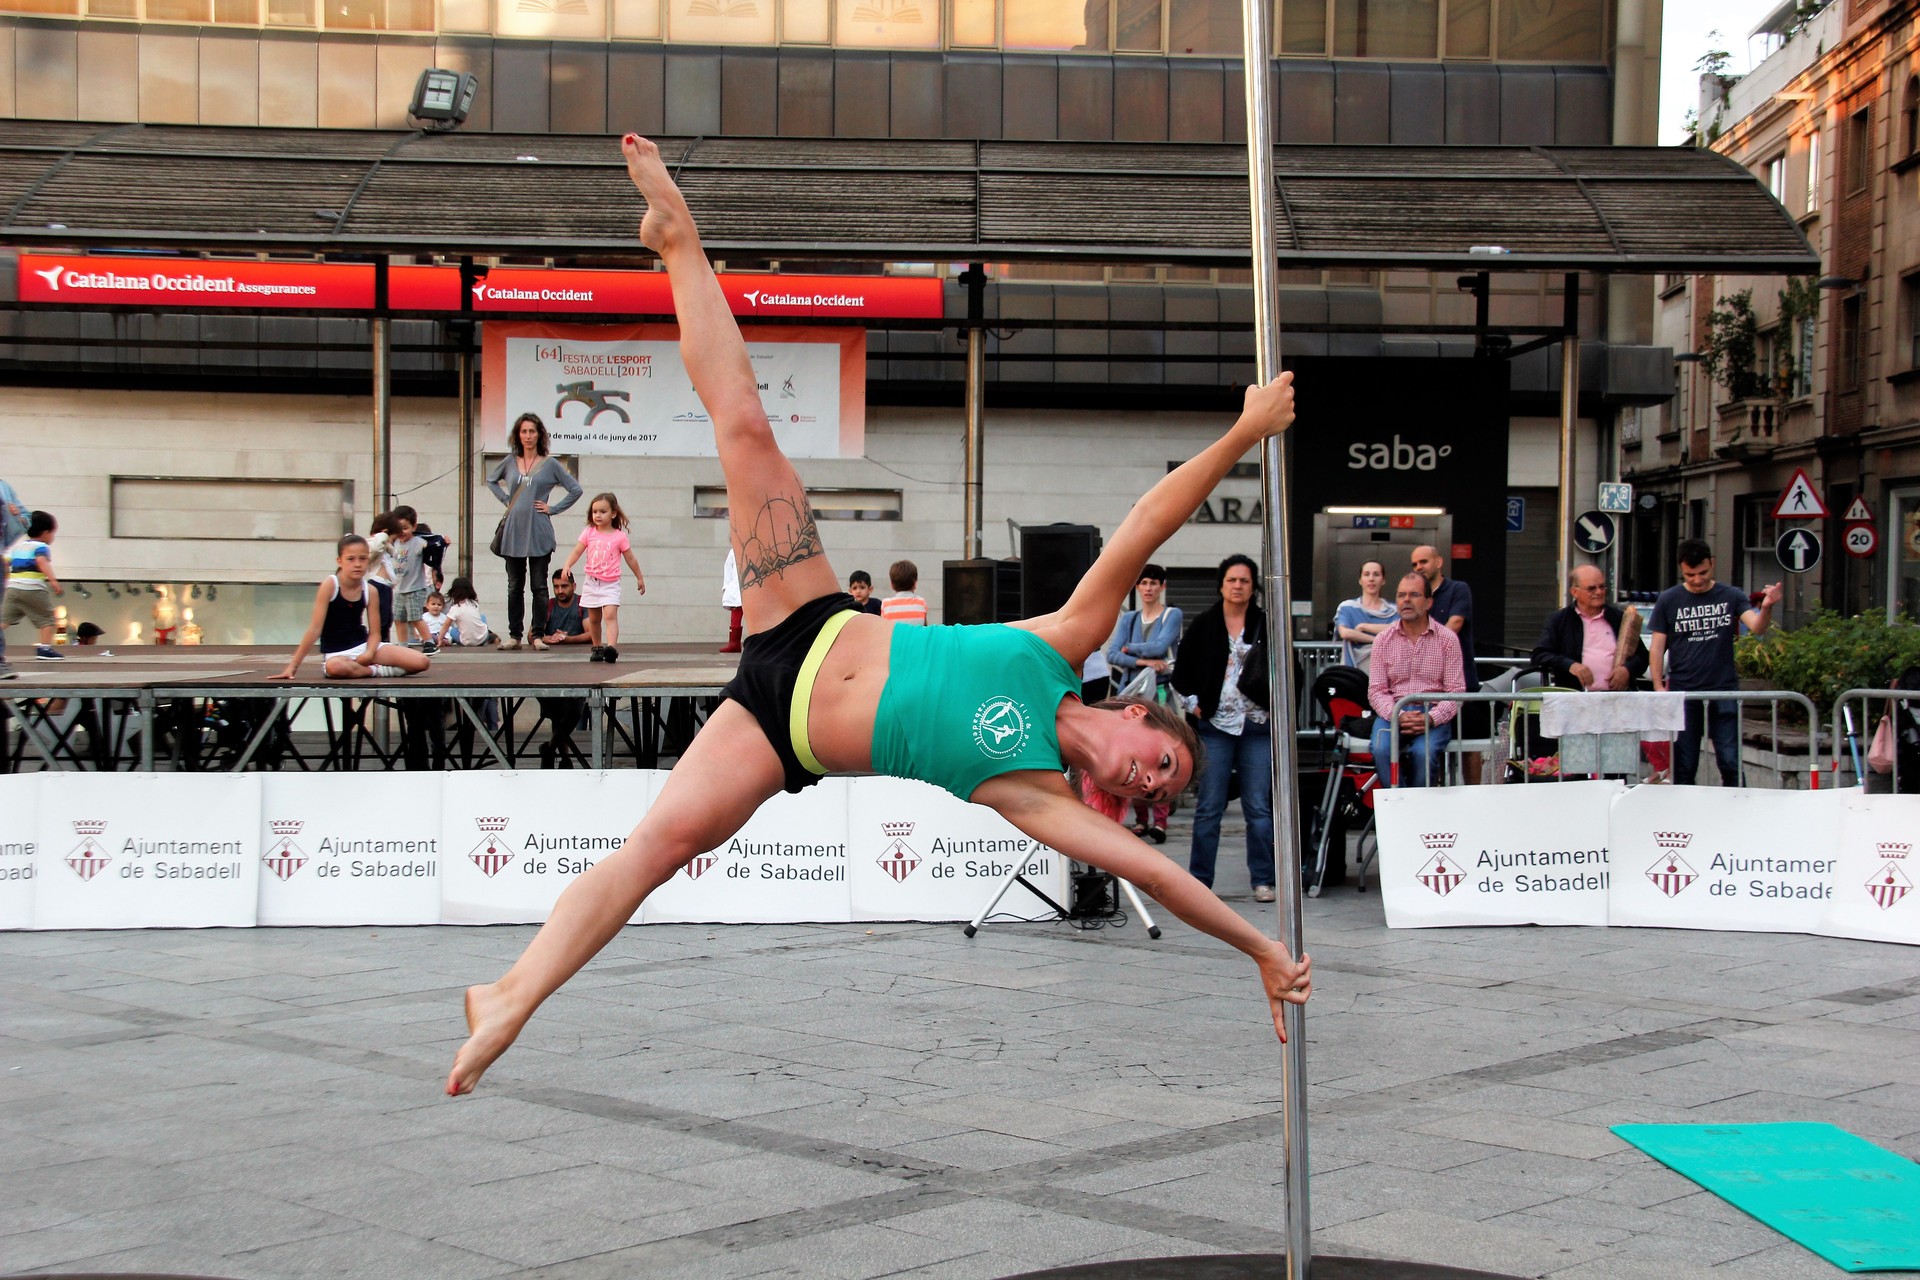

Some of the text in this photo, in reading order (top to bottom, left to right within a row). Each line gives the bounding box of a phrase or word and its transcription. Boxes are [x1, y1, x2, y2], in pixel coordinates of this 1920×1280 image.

[65, 271, 316, 296] Catalana Occident Assegurances
[487, 288, 593, 301] Catalana Occident
[760, 293, 864, 307] Catalana Occident
[563, 354, 590, 364] FESTA
[592, 355, 604, 364] DE
[607, 355, 652, 364] L'ESPORT
[563, 432, 582, 442] maig
[609, 433, 626, 442] juny
[1850, 533, 1870, 546] 20
[1676, 602, 1728, 620] ACADEMY
[1674, 614, 1731, 632] ATHLETICS
[122, 837, 242, 858] Ajuntament
[318, 836, 437, 858] Ajuntament
[524, 833, 628, 854] Ajuntame
[728, 838, 846, 859] Ajuntament
[523, 857, 547, 874] de
[1476, 847, 1610, 872] Ajuntament
[120, 861, 241, 879] de Sabadell
[317, 860, 436, 878] de Sabadell
[726, 862, 845, 881] de Sabadell
[931, 862, 955, 878] de
[1478, 871, 1610, 893] de Sabadell
[1709, 879, 1737, 896] de
